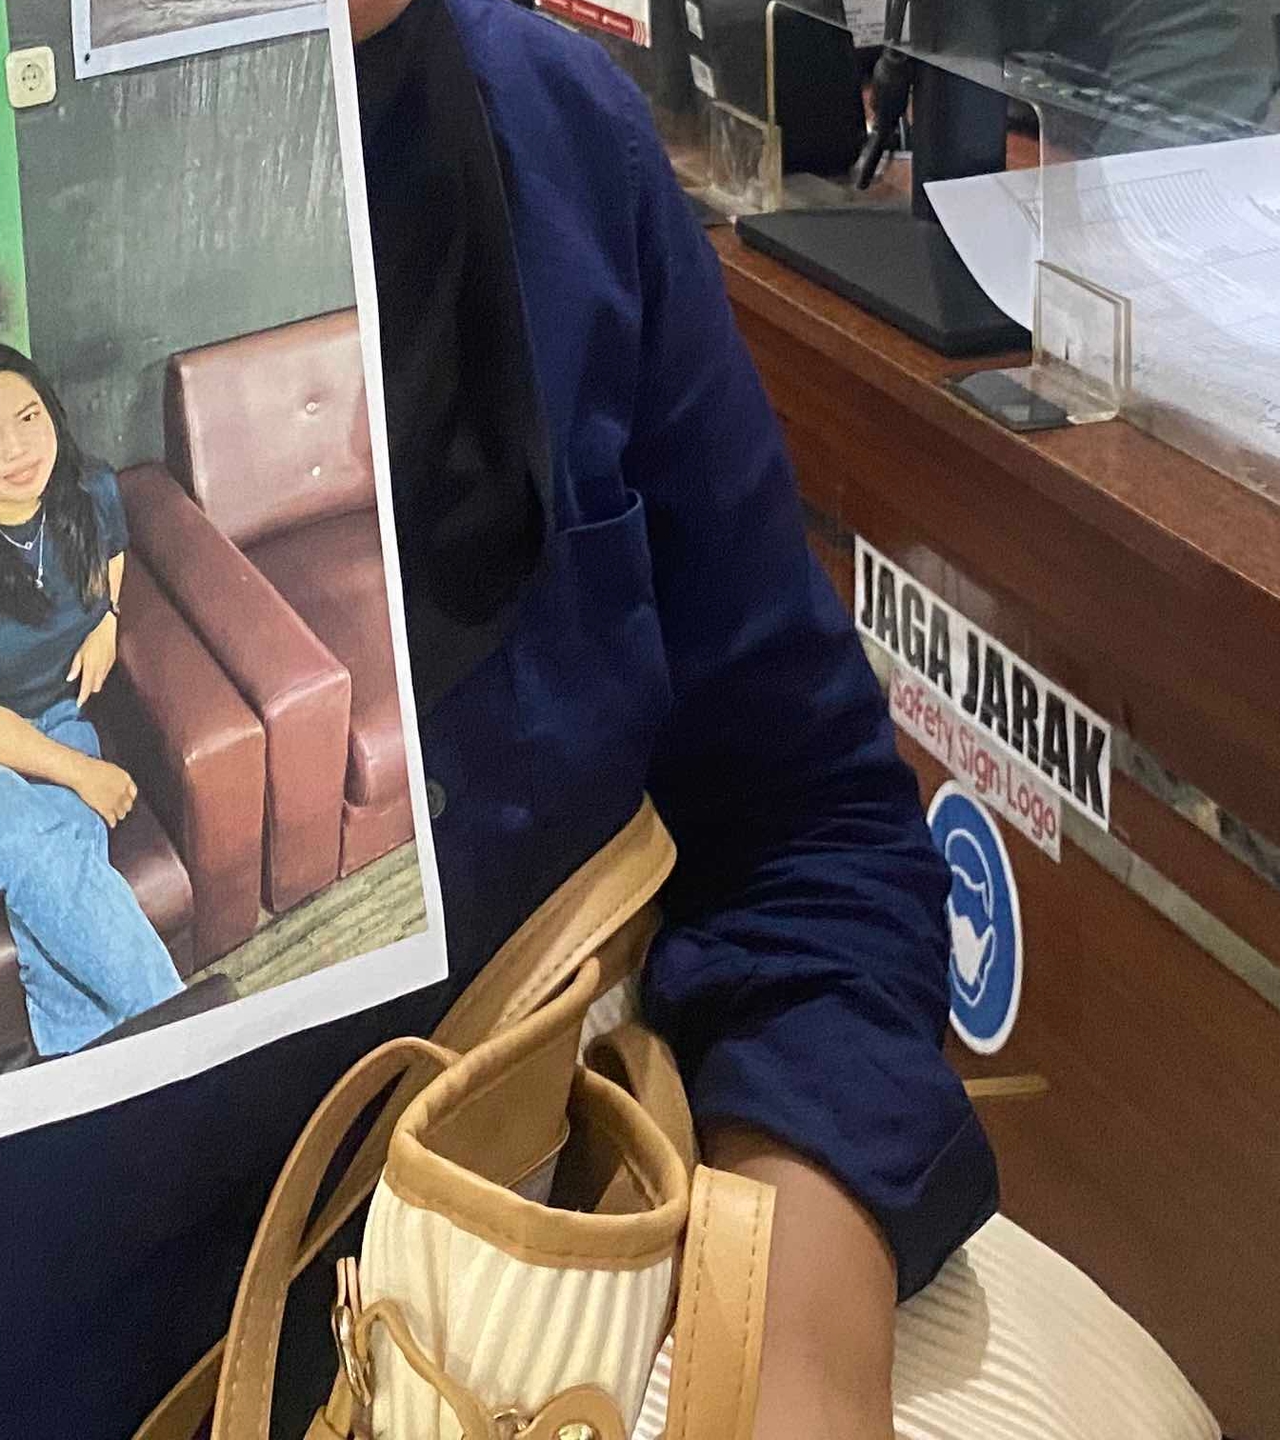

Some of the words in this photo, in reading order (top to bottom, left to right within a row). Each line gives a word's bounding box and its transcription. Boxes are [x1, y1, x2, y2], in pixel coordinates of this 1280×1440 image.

[861, 550, 952, 700] JAGA
[961, 628, 1107, 821] JARAK
[892, 670, 954, 762] Safety
[958, 730, 1001, 792] Sign
[1006, 762, 1055, 841] Logo
